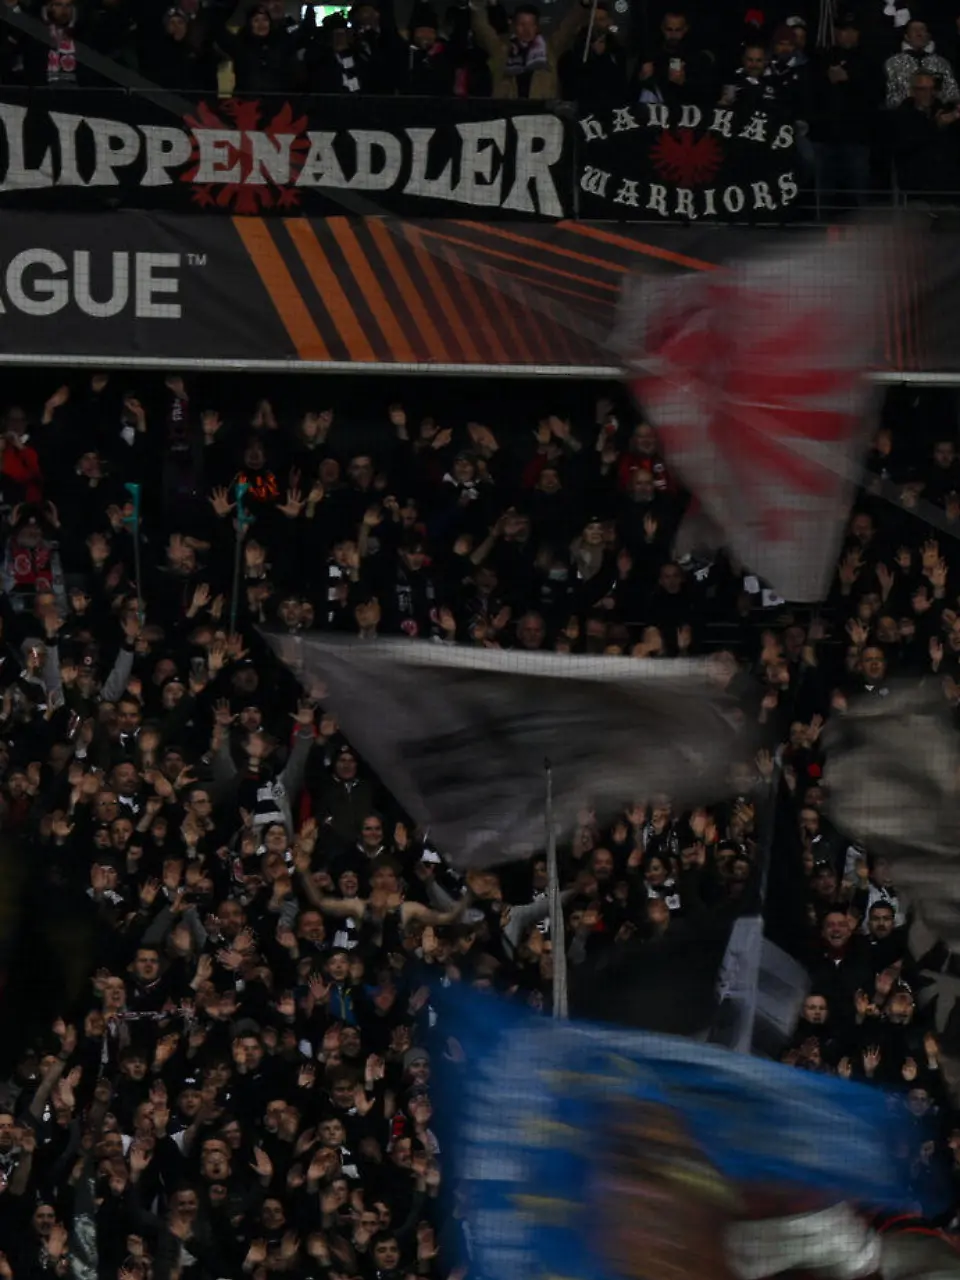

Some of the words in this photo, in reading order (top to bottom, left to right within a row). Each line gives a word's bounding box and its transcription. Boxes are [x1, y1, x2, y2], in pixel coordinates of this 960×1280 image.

[579, 103, 793, 150] HANDKÄS
[0, 104, 563, 217] LIPPENADLER
[580, 165, 798, 220] WARRIORS
[0, 248, 181, 318] GUE
